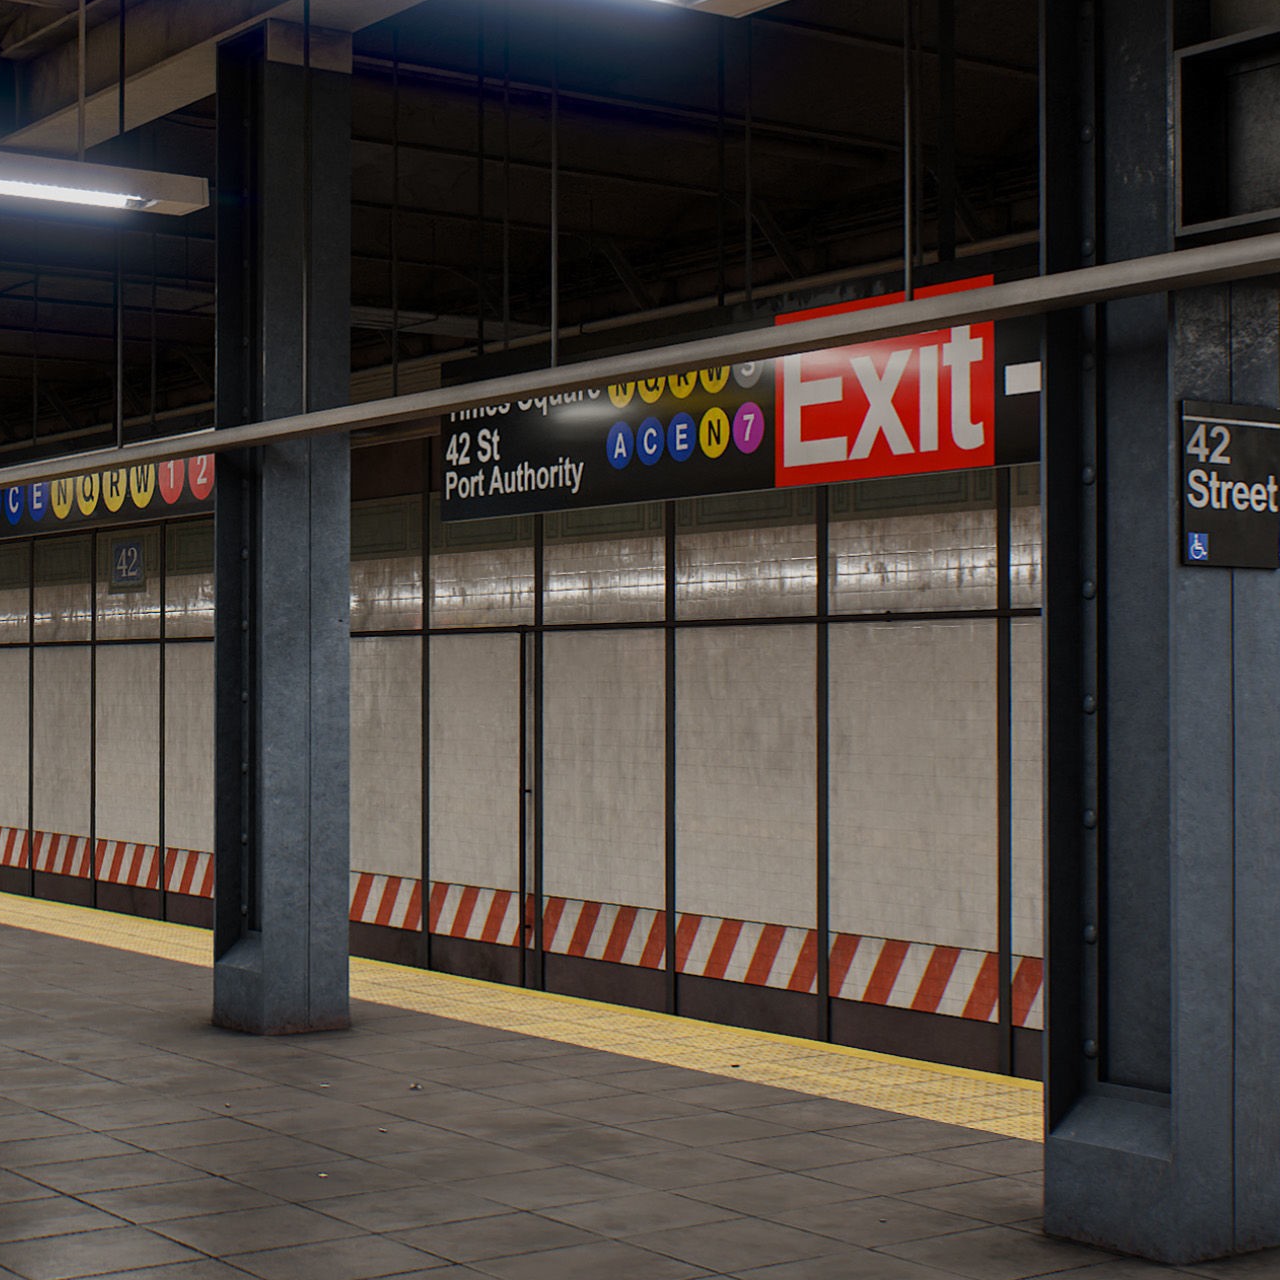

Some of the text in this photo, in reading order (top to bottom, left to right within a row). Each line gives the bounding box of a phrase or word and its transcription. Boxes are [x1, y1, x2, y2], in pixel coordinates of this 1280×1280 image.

[783, 324, 985, 468] Exit
[445, 428, 501, 466] 42 St
[614, 414, 755, 459] A C E N 7
[1186, 423, 1232, 465] 42
[8, 486, 19, 513] C
[32, 483, 43, 510] E
[56, 479, 67, 506] N
[82, 475, 95, 502] Q
[109, 470, 120, 498] R
[135, 464, 150, 494] W
[167, 460, 175, 489] 1
[196, 455, 208, 485] 2
[445, 456, 585, 500] Port Authority
[1187, 469, 1279, 513] Street
[116, 546, 138, 577] 42
